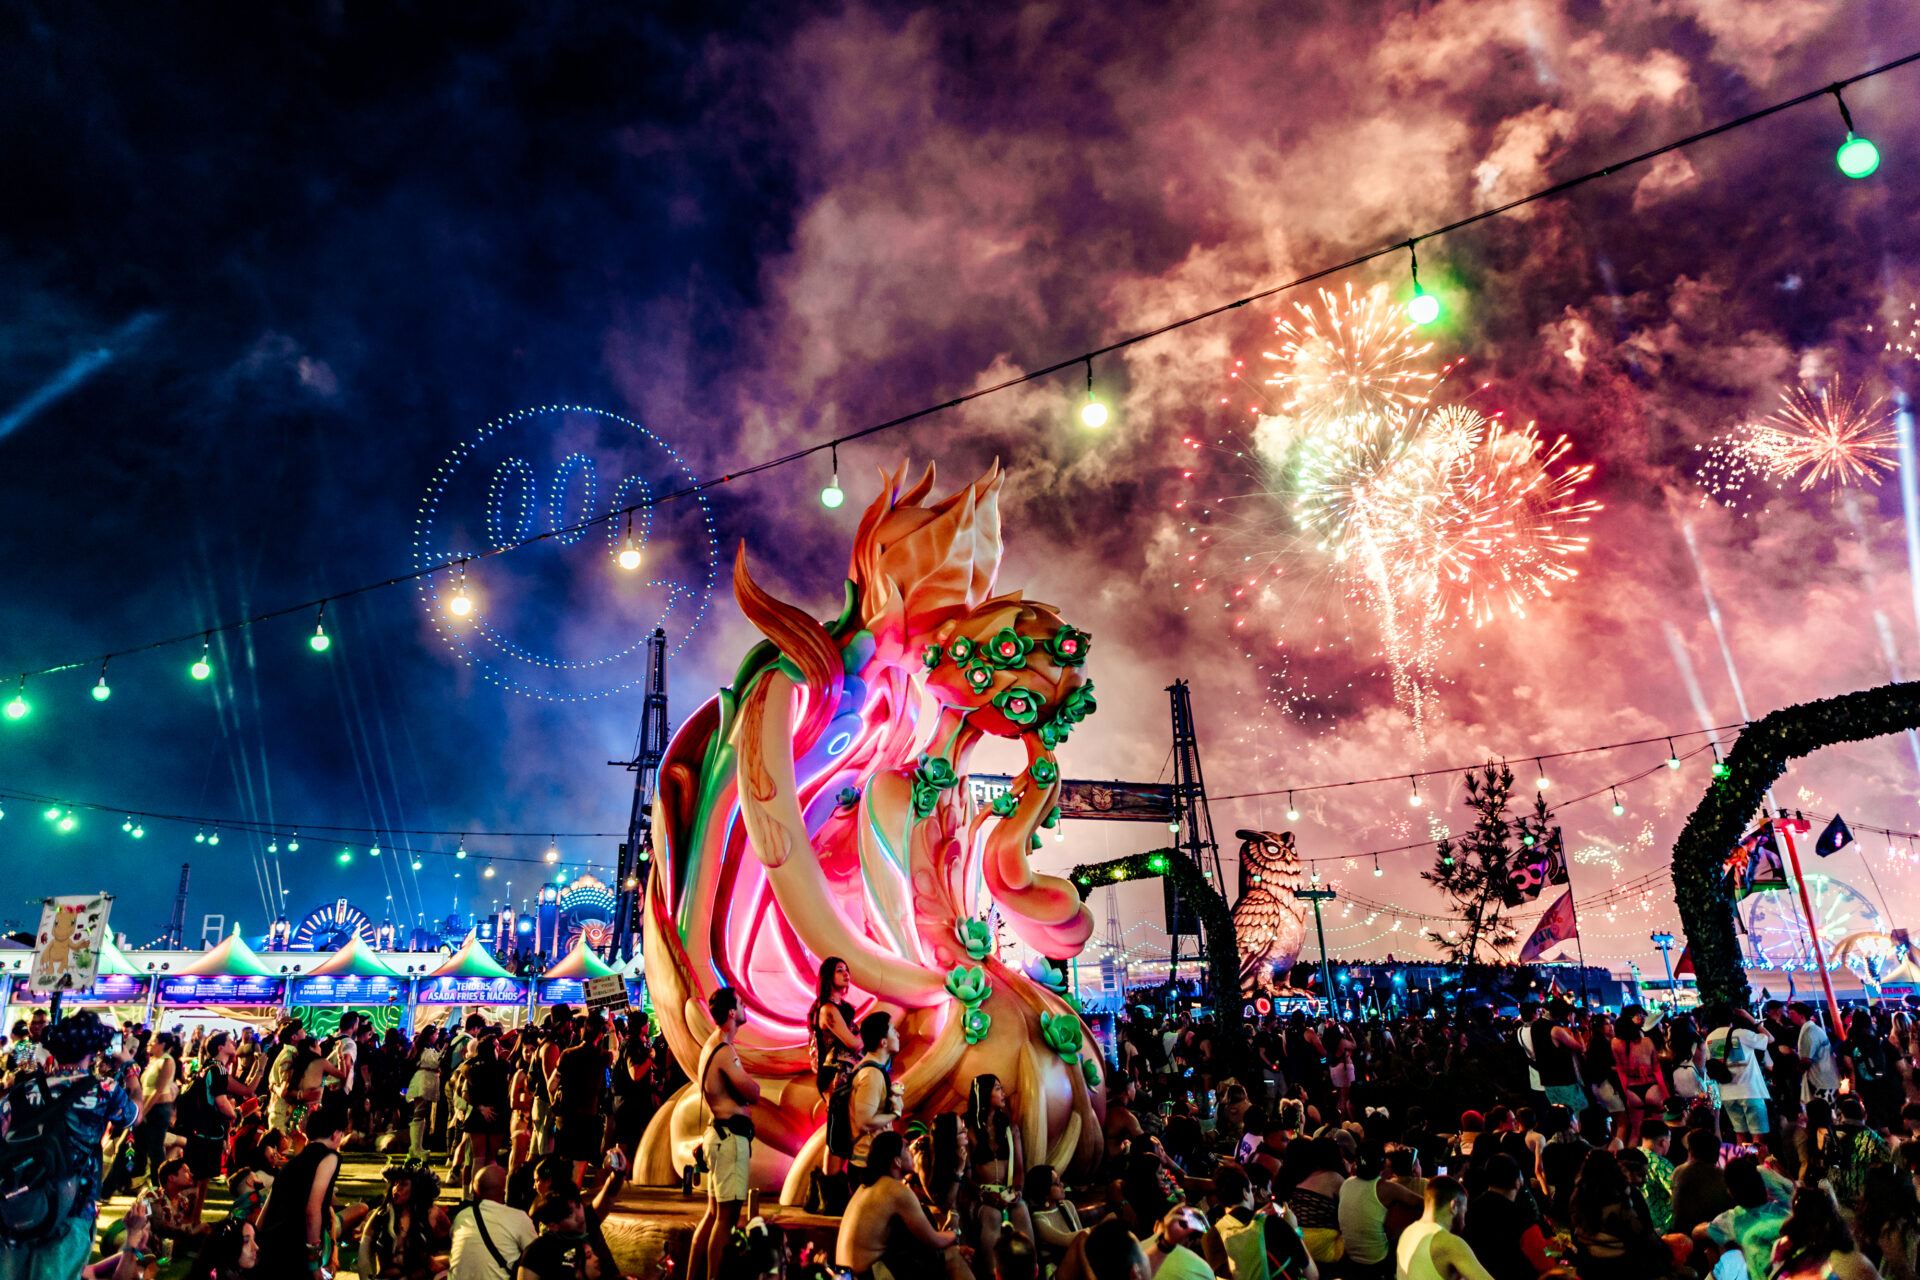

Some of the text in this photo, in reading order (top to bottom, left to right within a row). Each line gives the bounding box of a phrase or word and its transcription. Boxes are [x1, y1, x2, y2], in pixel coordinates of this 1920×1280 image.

[165, 985, 195, 994] SLIDERS
[456, 982, 492, 991] TENDERS,
[428, 992, 518, 1000] ASADA FRIES & NACHOS
